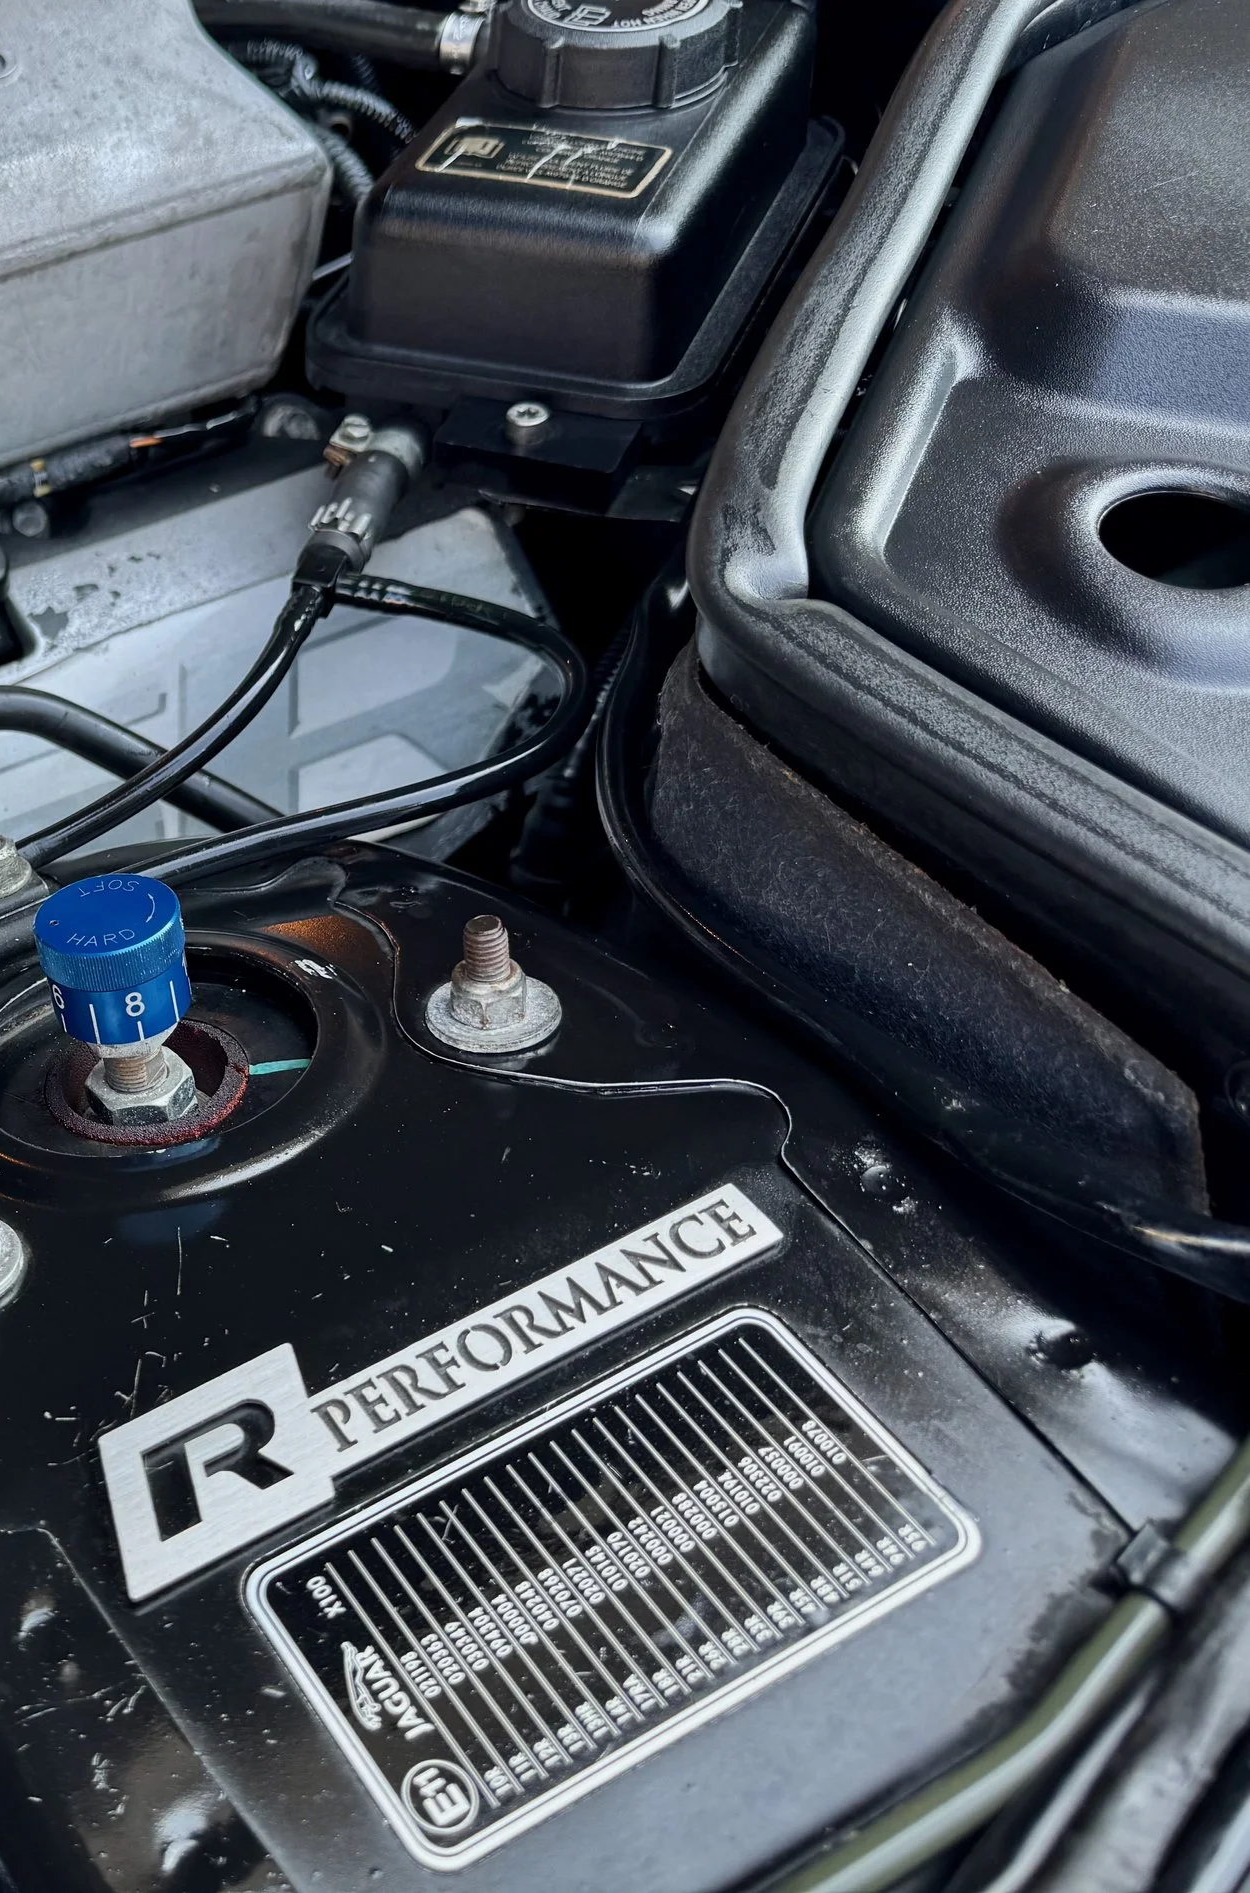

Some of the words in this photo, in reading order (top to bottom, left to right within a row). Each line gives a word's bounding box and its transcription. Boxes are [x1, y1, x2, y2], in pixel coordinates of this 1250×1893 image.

[78, 878, 140, 899] SOFT
[66, 928, 136, 948] HARD
[125, 991, 146, 1018] 8
[141, 1398, 295, 1542] R
[311, 1197, 758, 1453] PERFORMANCE
[783, 1435, 825, 1476] 010091
[801, 1420, 848, 1465] 010078
[737, 1456, 782, 1502] 022306
[757, 1446, 804, 1489] 000057
[693, 1479, 739, 1527] 015004
[716, 1468, 760, 1514] 010194
[650, 1505, 695, 1552] 000021
[671, 1492, 717, 1539] 000288
[897, 1523, 928, 1552] 95R
[606, 1531, 651, 1578] 020170
[627, 1516, 673, 1565] 000242
[562, 1557, 605, 1604] 020271
[584, 1545, 628, 1591] 010145
[832, 1562, 865, 1590] 51R
[306, 1575, 347, 1619] X100
[514, 1580, 559, 1630] 040248
[537, 1567, 583, 1617] 070268
[766, 1600, 796, 1629] 39R
[467, 1606, 513, 1657] 094304
[490, 1593, 538, 1644] 000004
[420, 1633, 465, 1684] 020363
[444, 1621, 489, 1670] 030349
[698, 1641, 729, 1670] 26R
[400, 1651, 441, 1698] 021198
[651, 1668, 680, 1696] 18R
[675, 1654, 704, 1683] 21R
[355, 1645, 436, 1740] JAGUAR
[605, 1695, 633, 1725] 14R
[622, 1673, 656, 1710] 17RA
[533, 1737, 561, 1767] 12R
[556, 1723, 586, 1752] 13R
[484, 1765, 516, 1796] 10R
[508, 1751, 538, 1781] 11R
